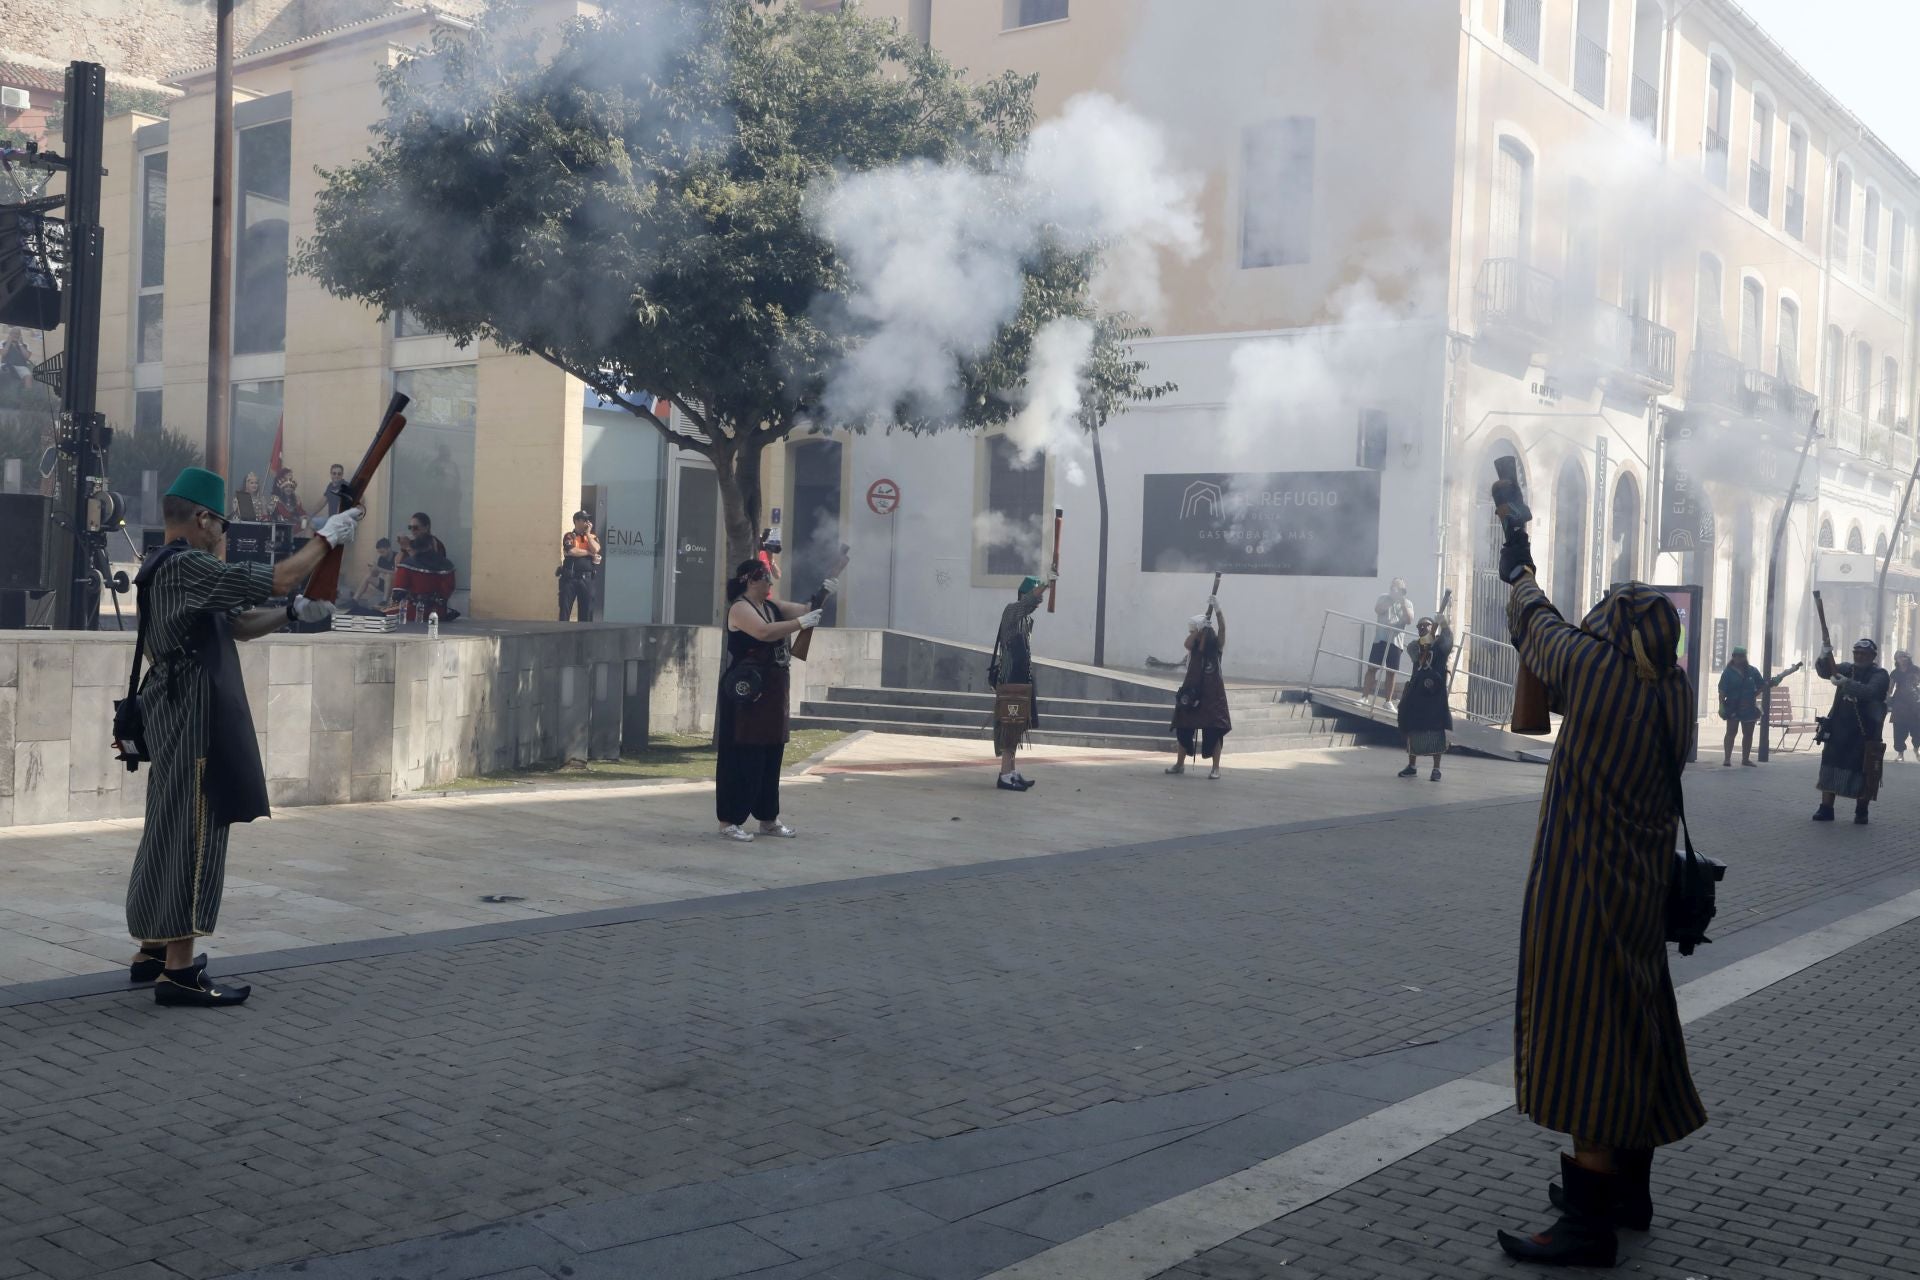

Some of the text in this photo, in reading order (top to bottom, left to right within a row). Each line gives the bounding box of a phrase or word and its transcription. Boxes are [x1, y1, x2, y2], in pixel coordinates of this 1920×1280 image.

[1675, 427, 1693, 492] REFIO
[1260, 491, 1338, 507] REFUGIO
[1673, 502, 1686, 514] EL
